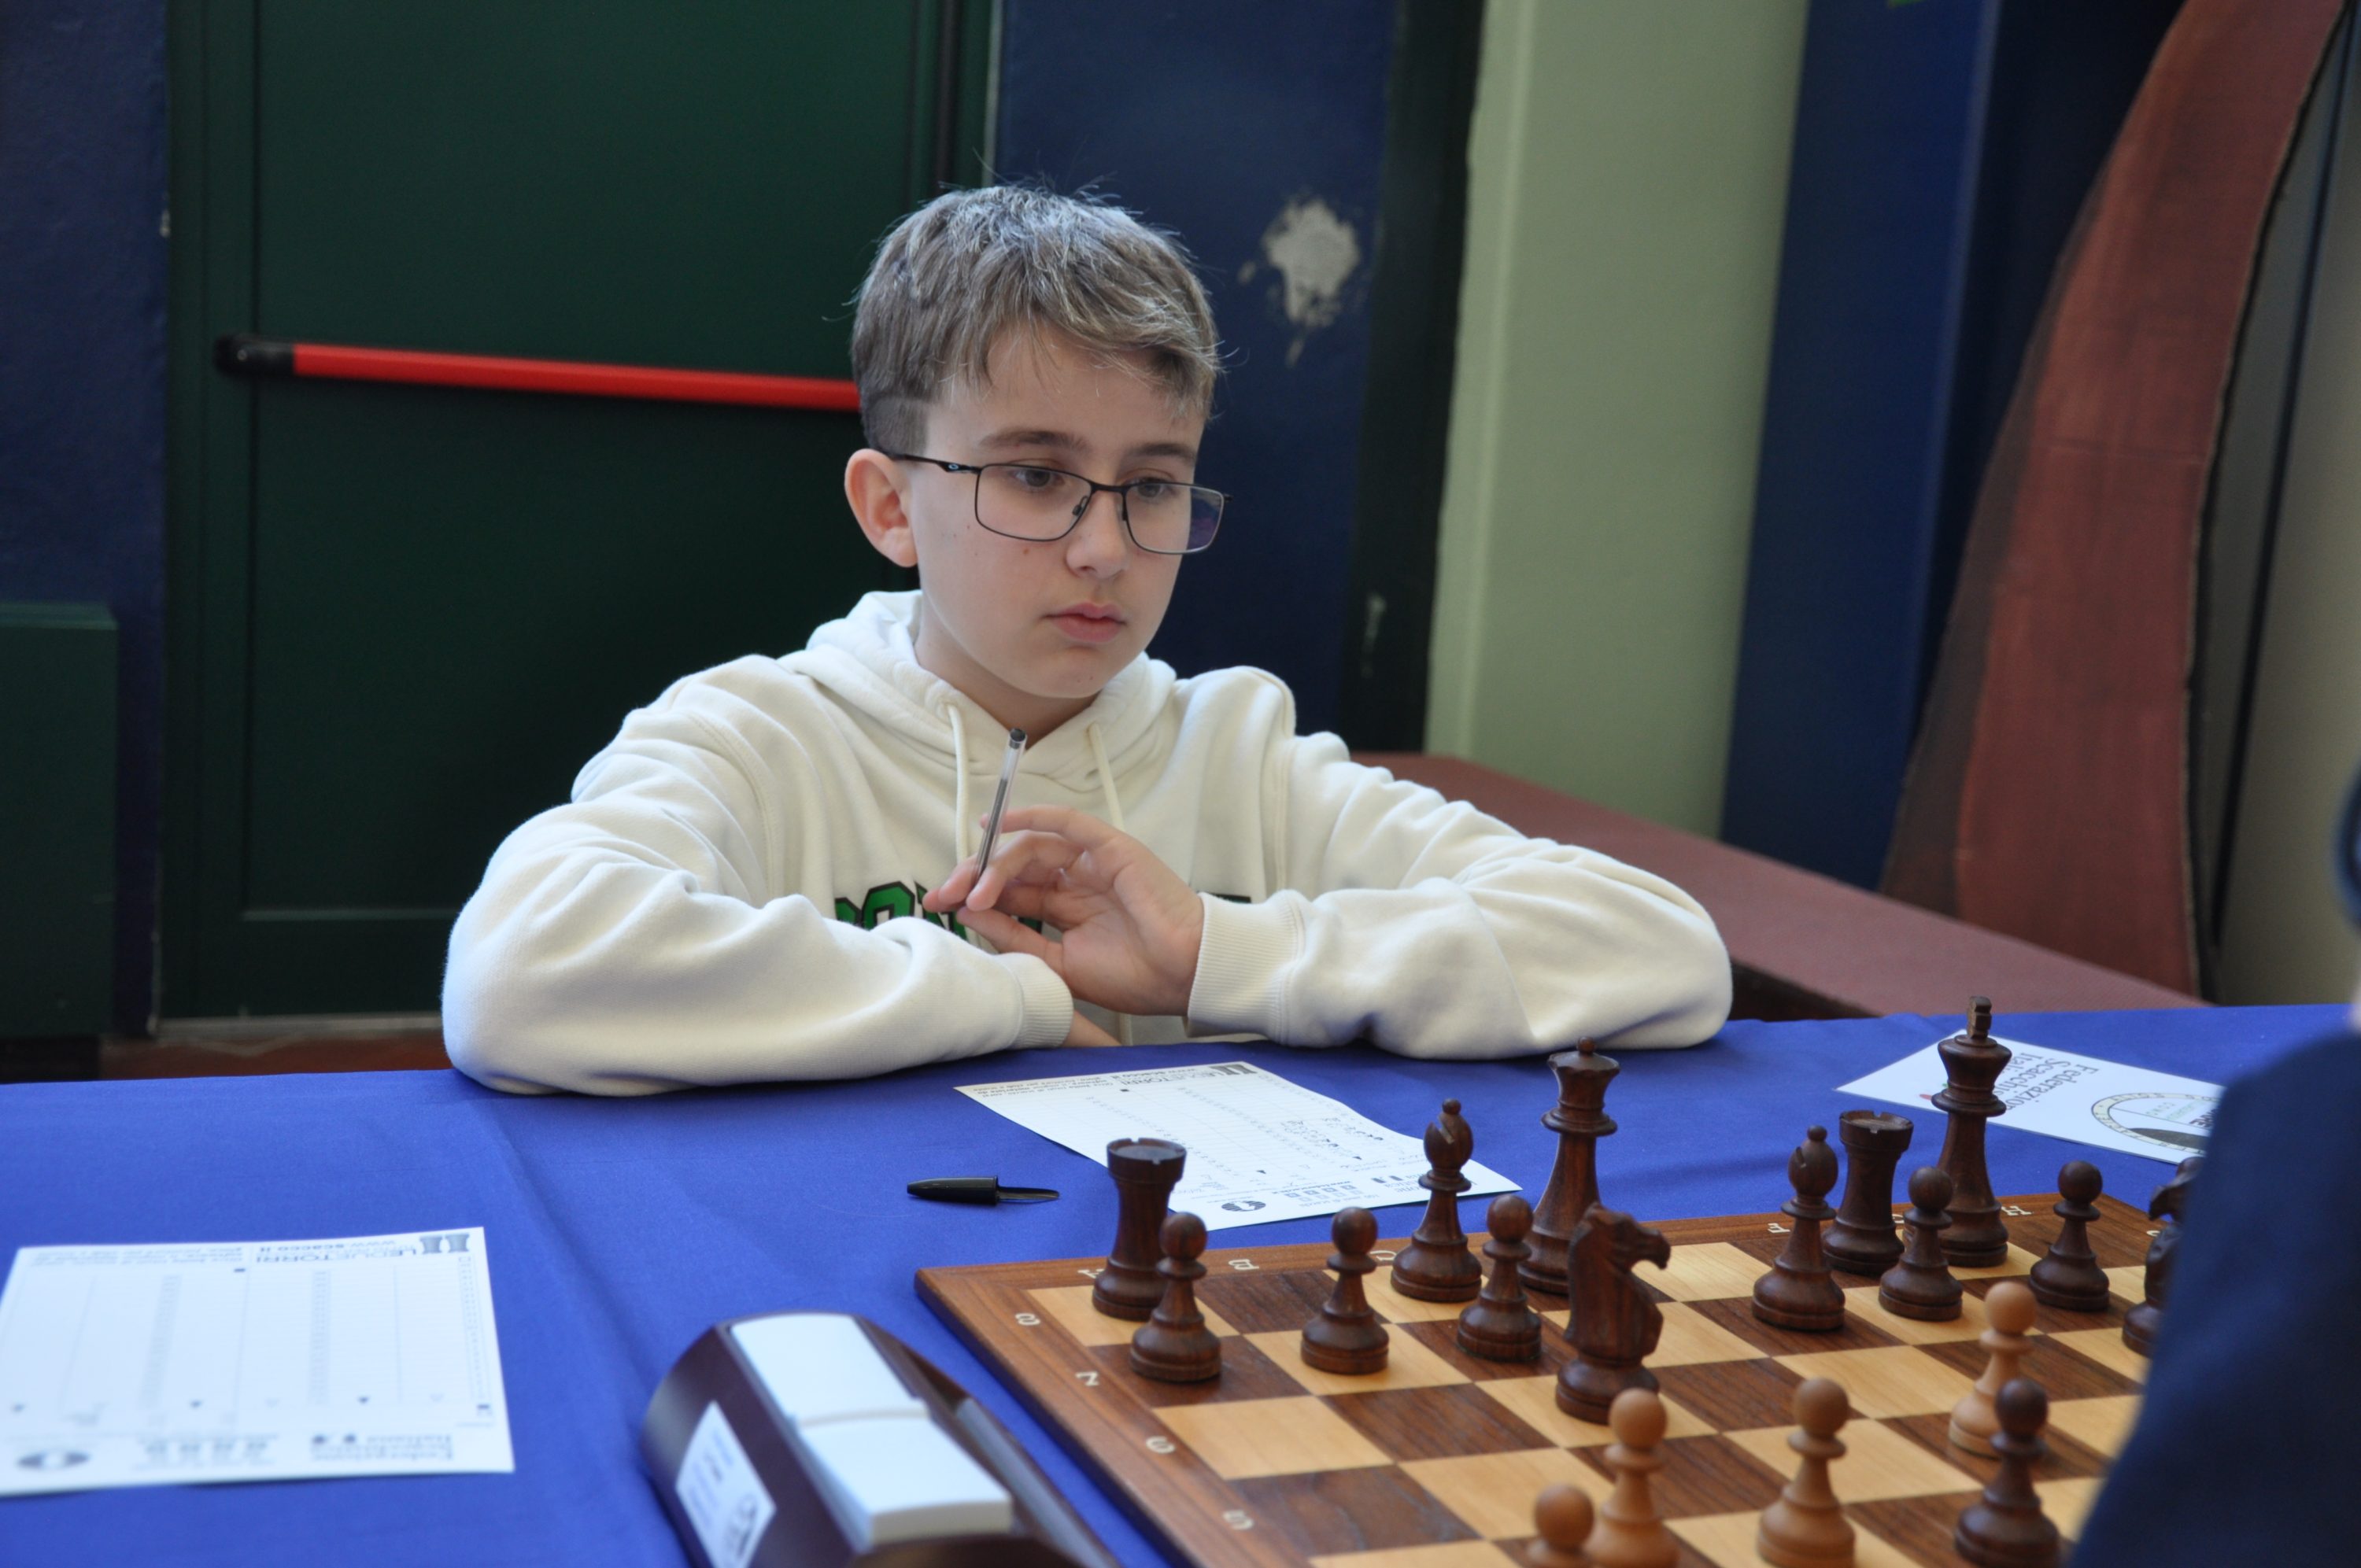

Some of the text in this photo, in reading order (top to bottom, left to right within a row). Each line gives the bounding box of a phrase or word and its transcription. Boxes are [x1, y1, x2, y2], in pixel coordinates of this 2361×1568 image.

[1229, 1258, 1260, 1271] B
[1014, 1312, 1041, 1326] 8
[1075, 1371, 1099, 1386] 7
[1146, 1435, 1176, 1454] 6
[1222, 1509, 1254, 1530] 5
